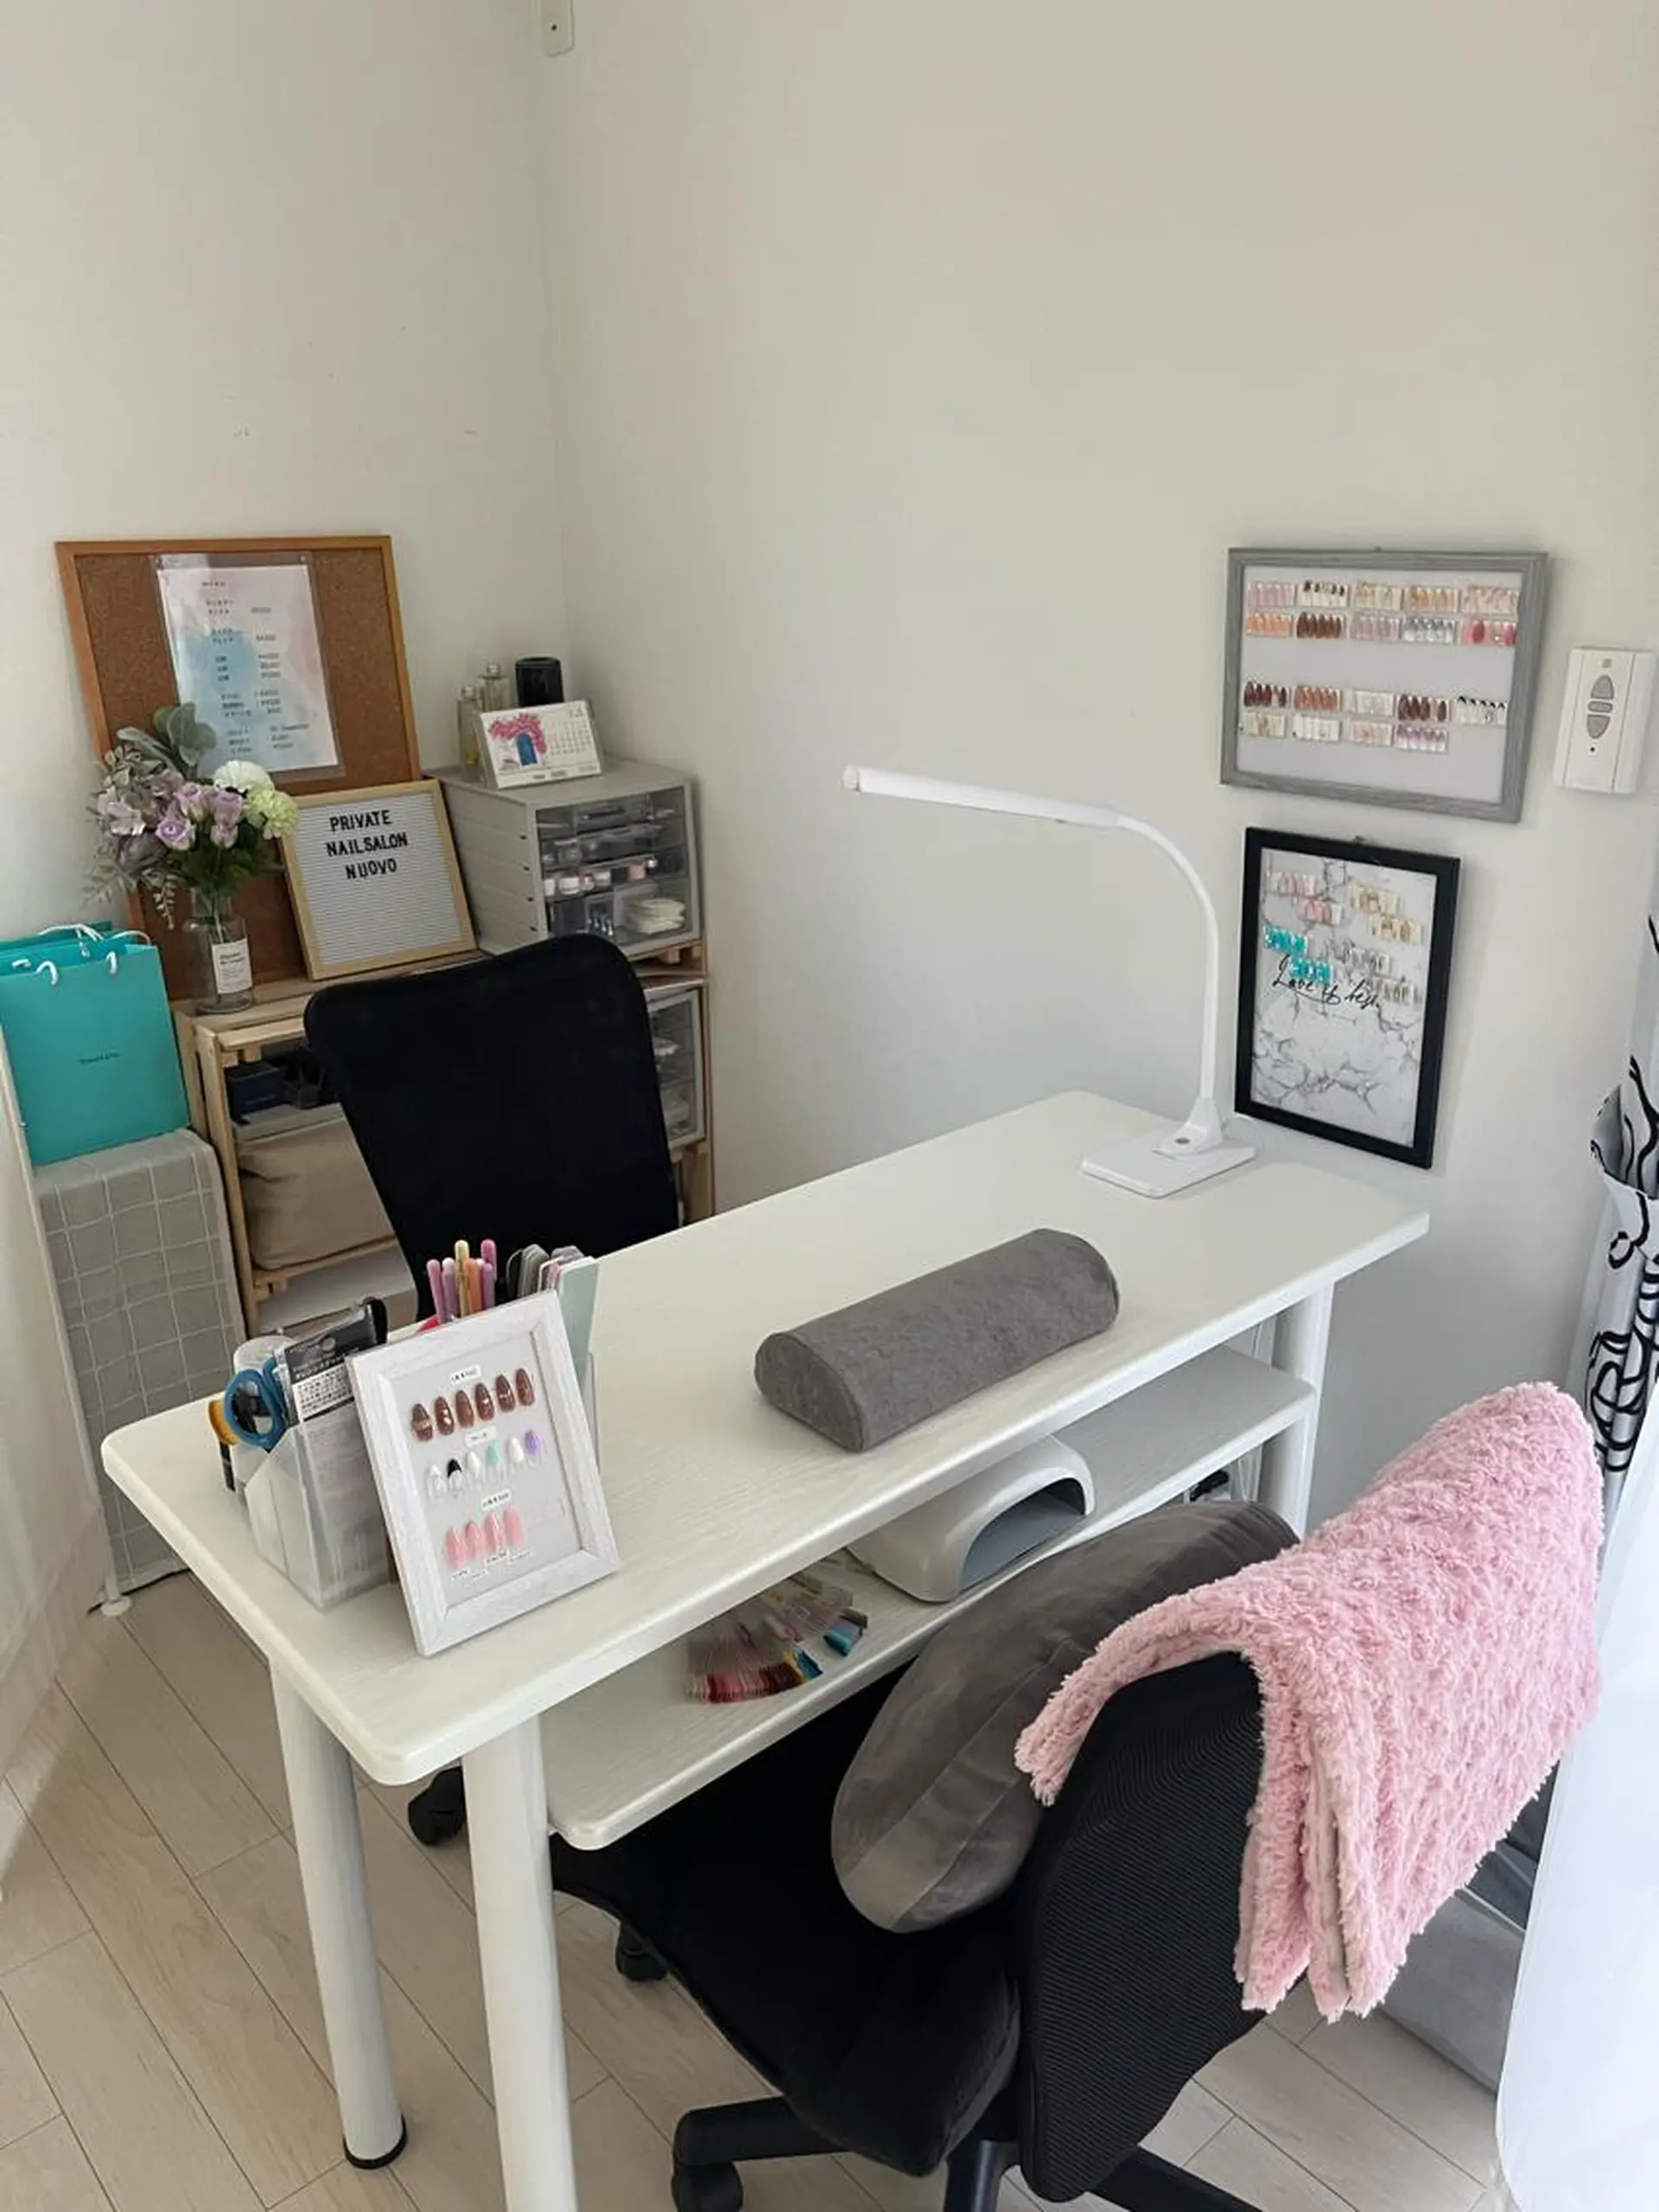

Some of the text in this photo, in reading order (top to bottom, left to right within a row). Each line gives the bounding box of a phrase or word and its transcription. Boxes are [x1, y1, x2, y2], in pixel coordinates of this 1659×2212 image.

[329, 810, 393, 832] PRIVATE
[325, 832, 408, 857] NAILSALON
[346, 857, 397, 880] NUOVO
